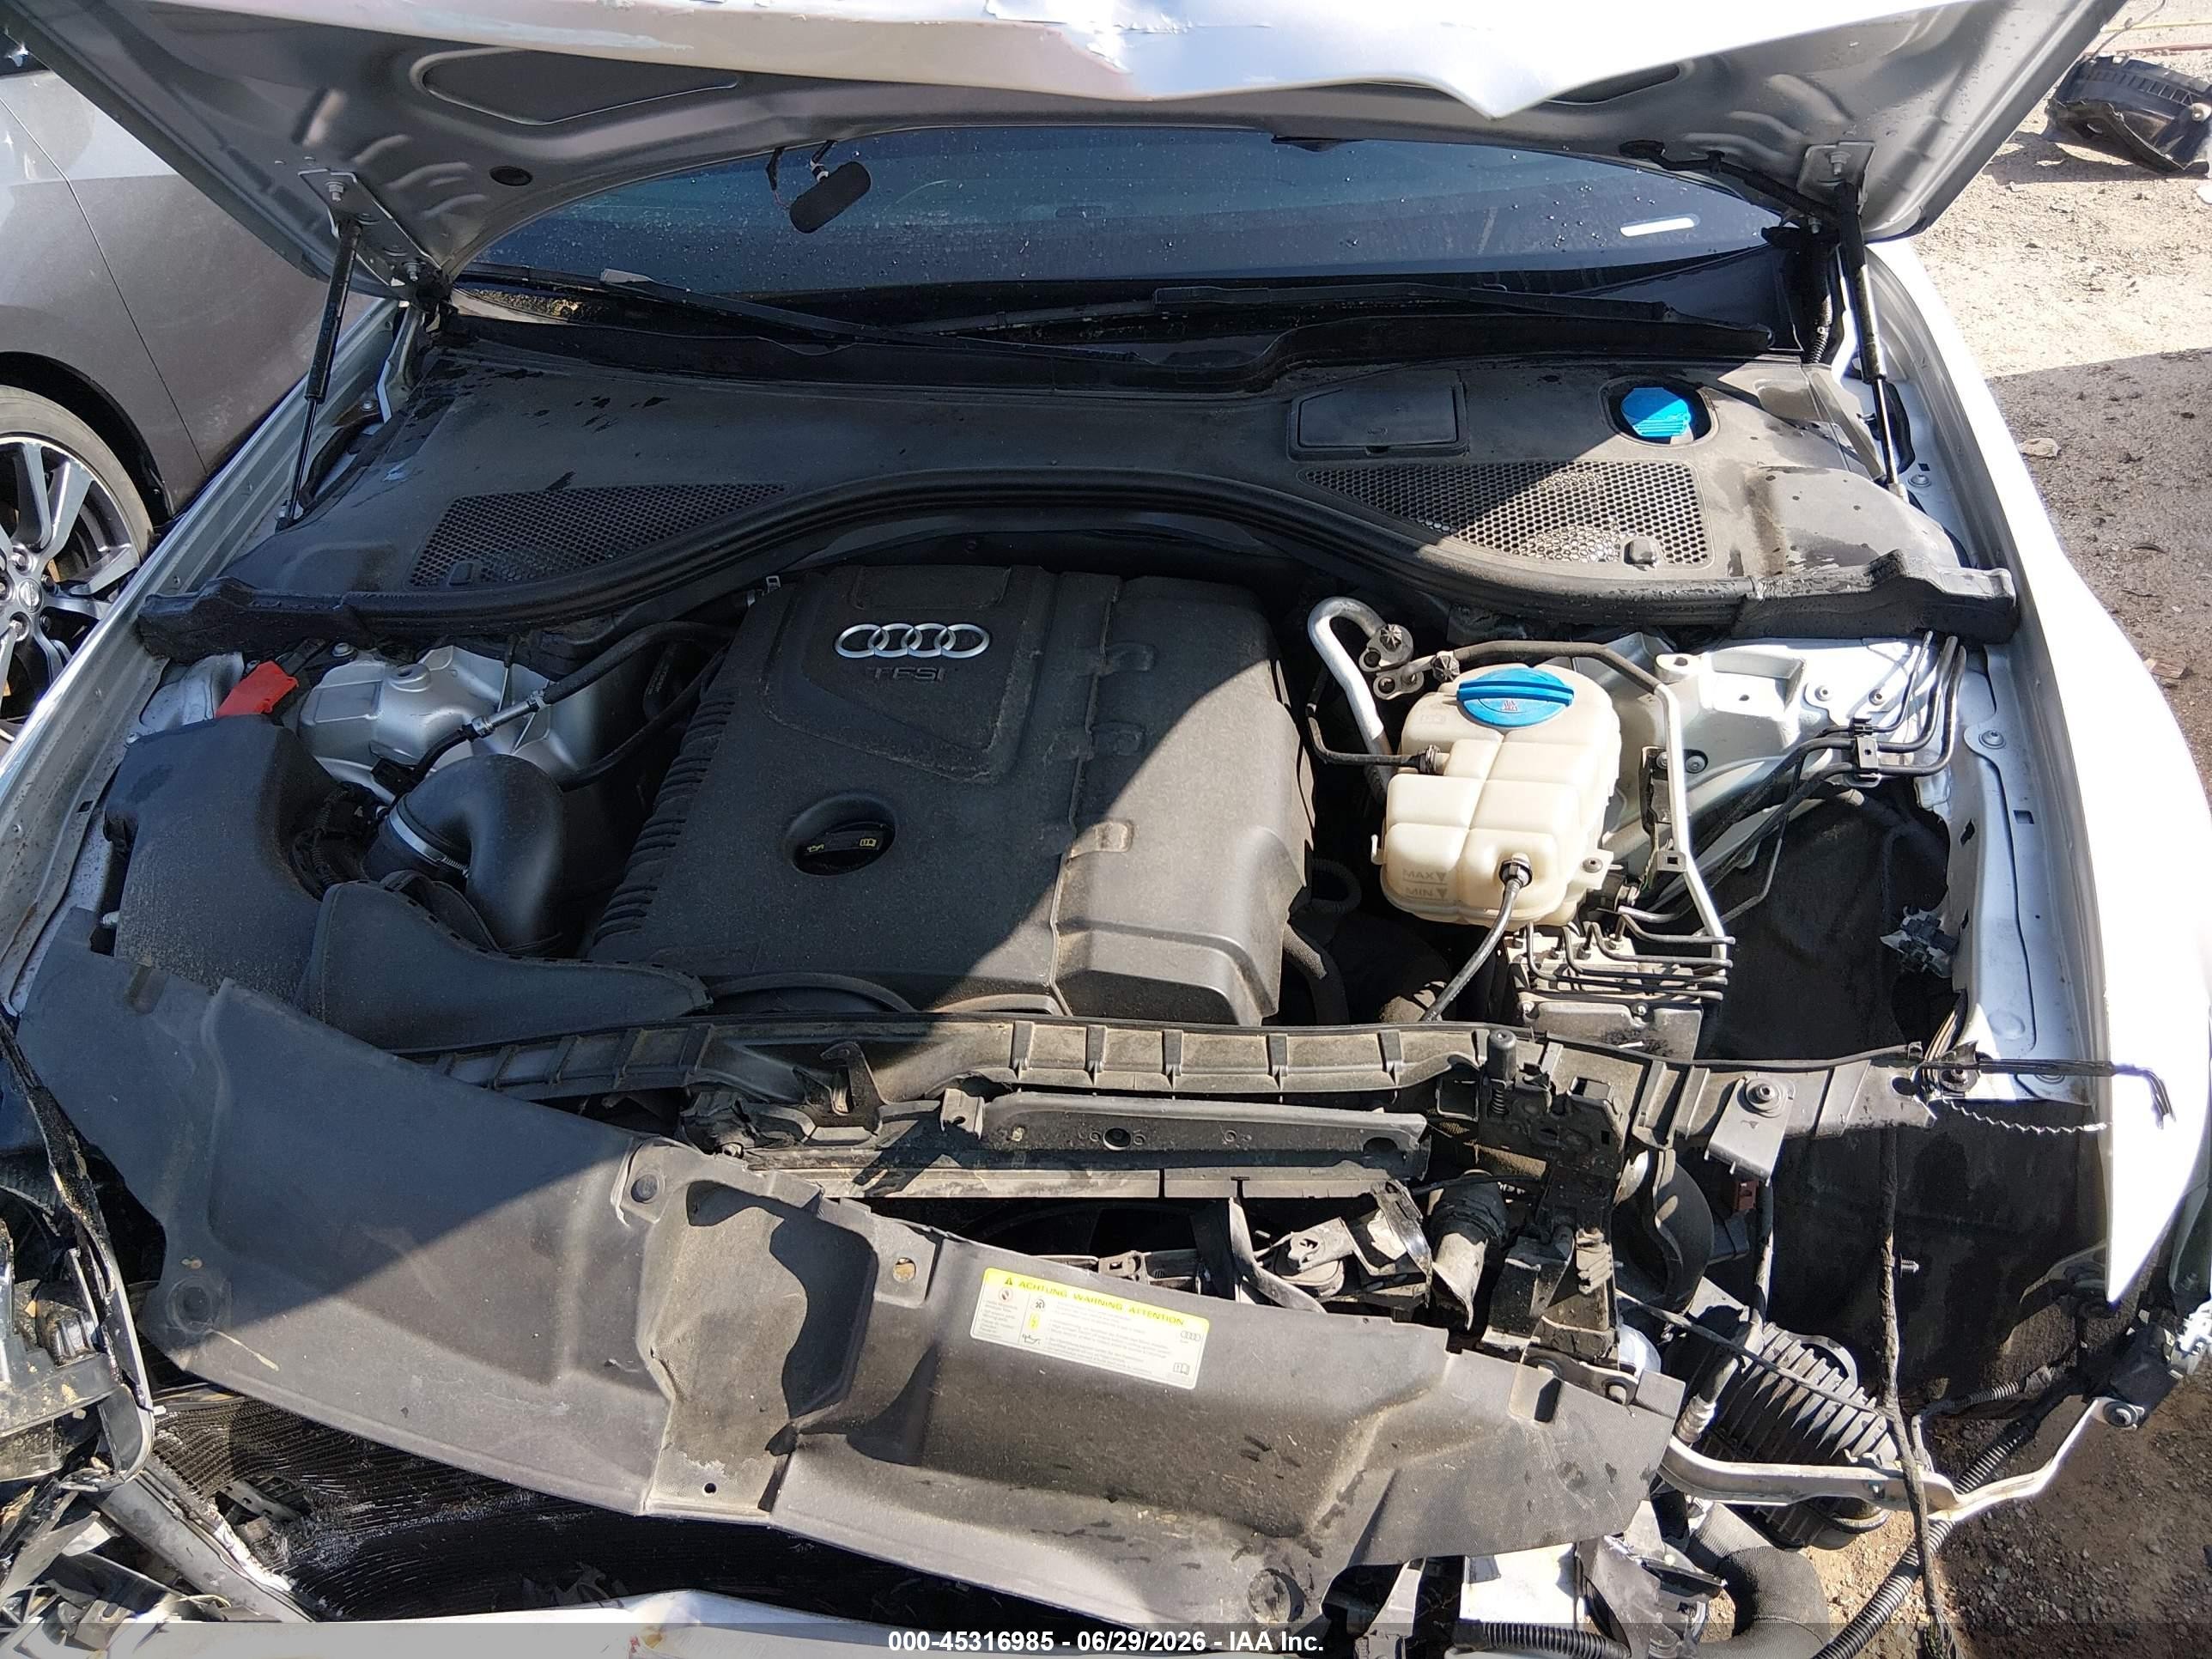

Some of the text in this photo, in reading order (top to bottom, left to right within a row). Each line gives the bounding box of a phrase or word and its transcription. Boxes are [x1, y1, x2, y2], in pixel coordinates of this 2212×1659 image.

[866, 666, 944, 681] TFSI
[1402, 868, 1435, 879] MAX
[1406, 886, 1433, 896] MIN
[1018, 1280, 1068, 1297] ACHTUNG
[1073, 1292, 1122, 1310] WARNING
[1128, 1306, 1184, 1325] ATTENTION
